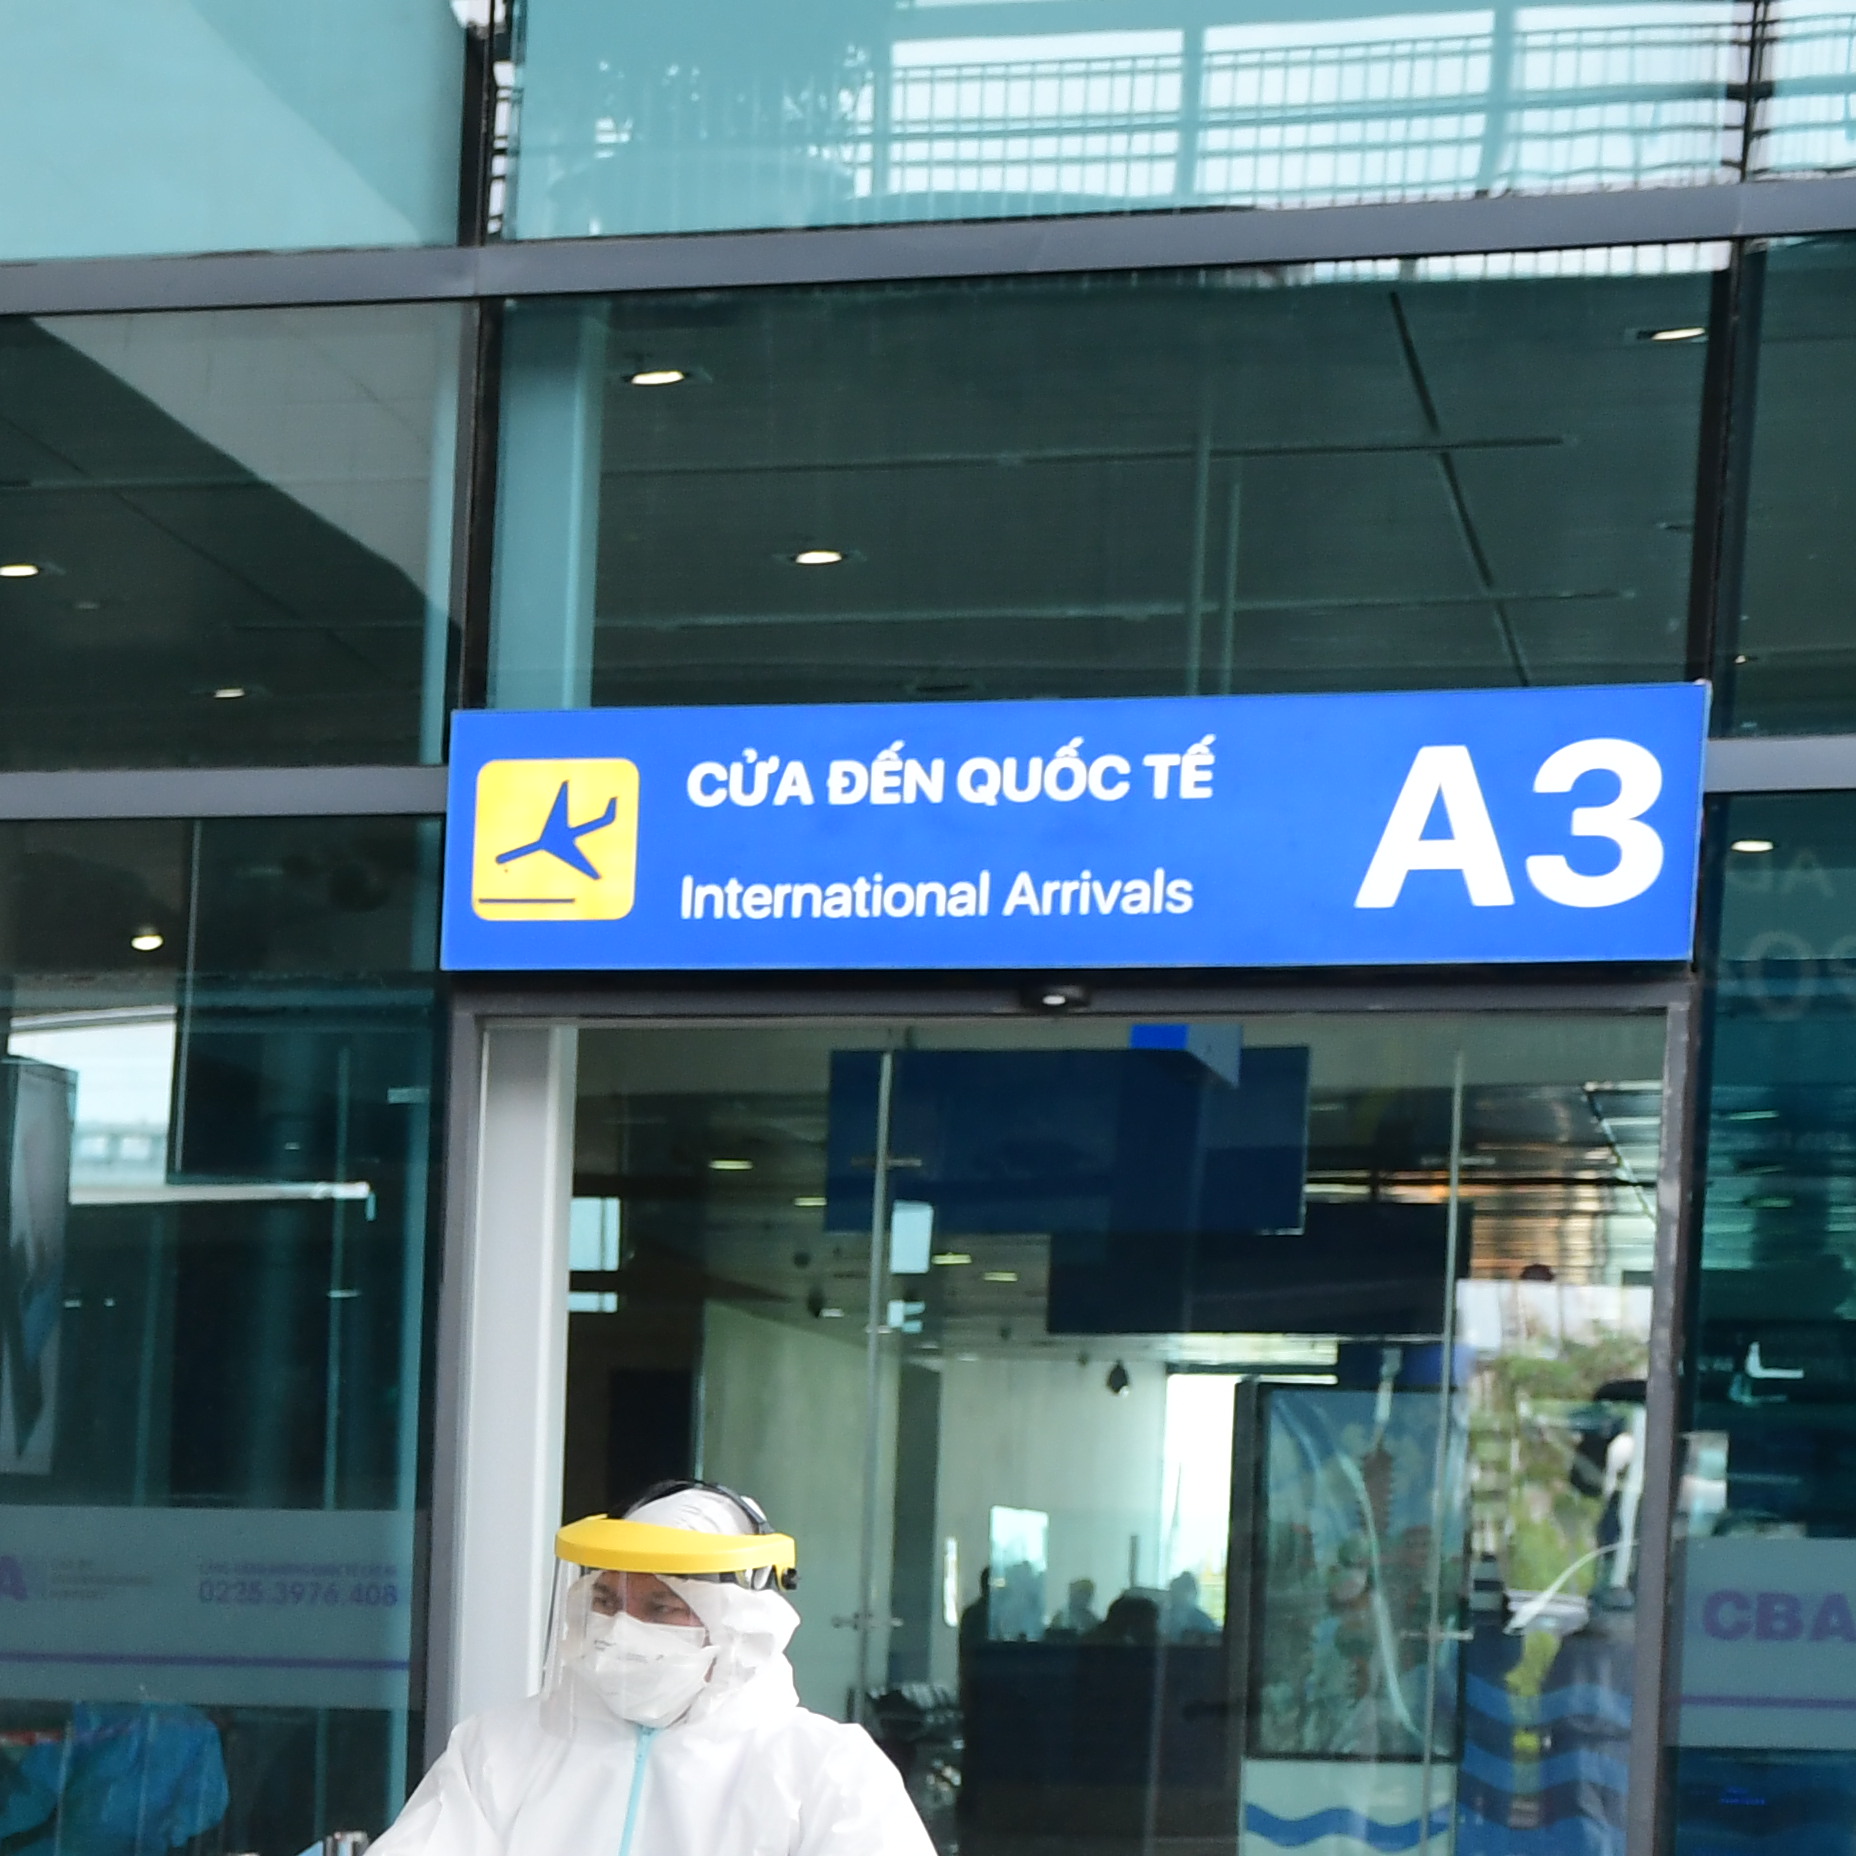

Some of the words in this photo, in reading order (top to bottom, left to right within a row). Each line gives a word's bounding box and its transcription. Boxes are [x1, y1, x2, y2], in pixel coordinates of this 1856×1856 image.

[686, 746, 816, 808] CỬA
[826, 739, 946, 806] ĐẾN
[955, 736, 1131, 807] QUỐC
[1142, 733, 1218, 800] TẾ
[1350, 736, 1668, 911] A3
[680, 869, 991, 920] International
[1001, 867, 1195, 918] Arrivals
[1702, 1589, 1856, 1642] CBA
